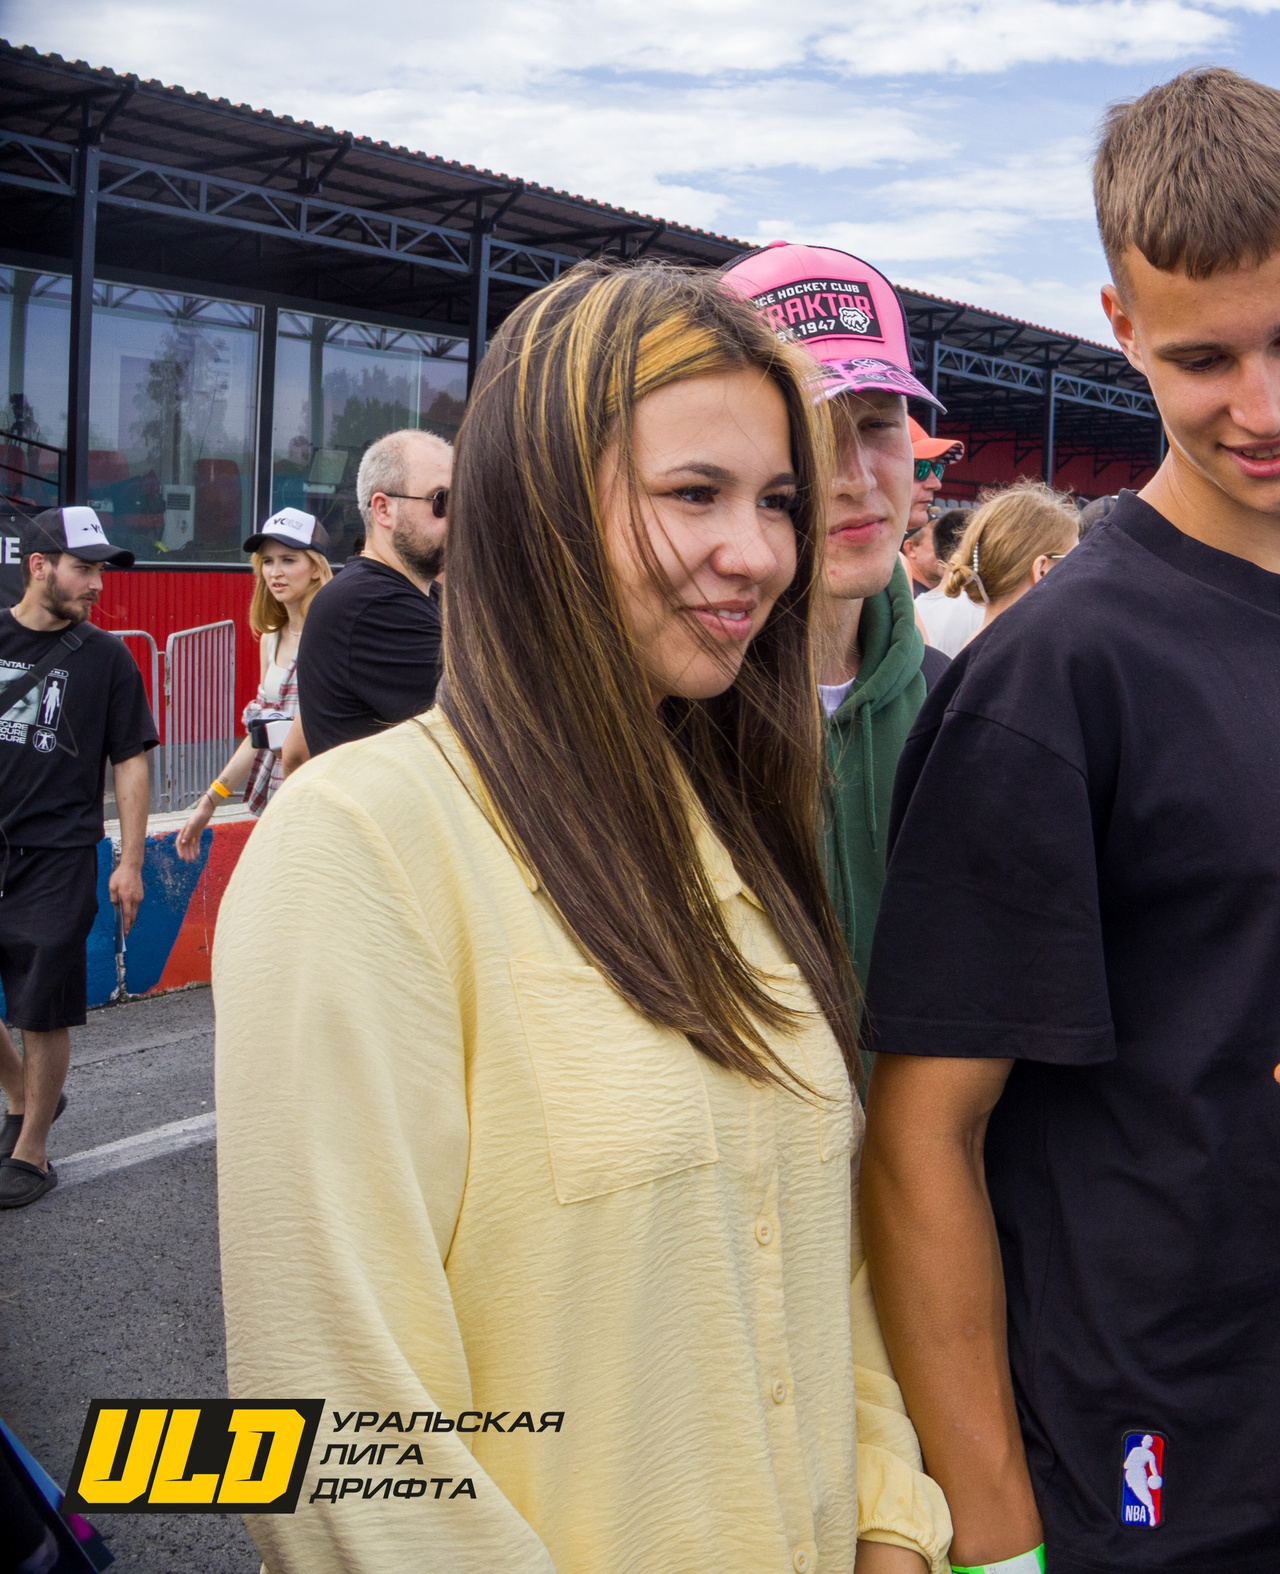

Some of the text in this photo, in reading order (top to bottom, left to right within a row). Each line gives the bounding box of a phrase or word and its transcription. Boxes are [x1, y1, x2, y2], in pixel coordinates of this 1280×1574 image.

[777, 282, 827, 300] HOCKEY
[830, 282, 860, 293] CLUB
[1125, 1504, 1147, 1522] NBA
